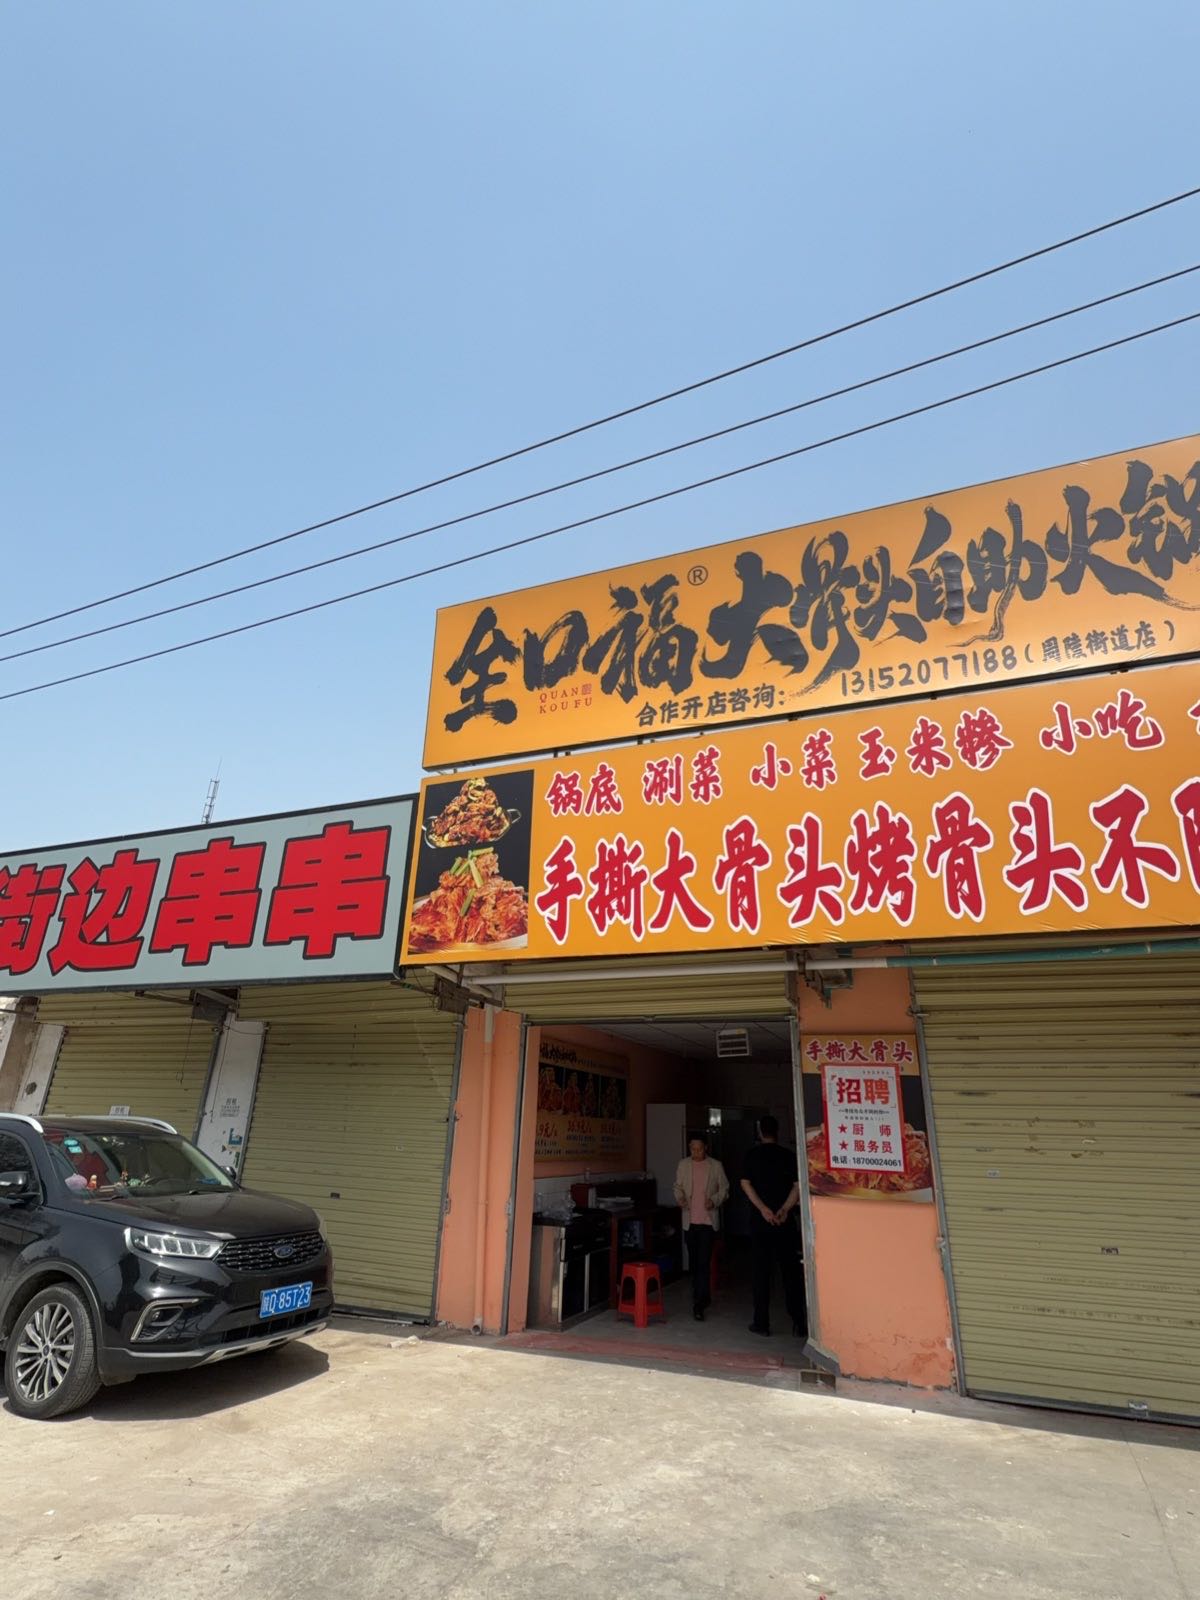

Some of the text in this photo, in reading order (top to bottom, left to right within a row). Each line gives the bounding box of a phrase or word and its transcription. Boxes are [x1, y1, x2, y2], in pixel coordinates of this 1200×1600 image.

[540, 687, 578, 703] QUAN
[545, 763, 623, 816] 锅底
[642, 745, 722, 804] 涮菜
[750, 728, 837, 790] 小菜
[1040, 688, 1165, 755] 小吃
[536, 777, 1200, 945] 手撕大骨头烤骨头不
[806, 1040, 913, 1062] 手撕大骨头
[836, 1077, 890, 1104] 招聘
[854, 1140, 893, 1154] 服务员
